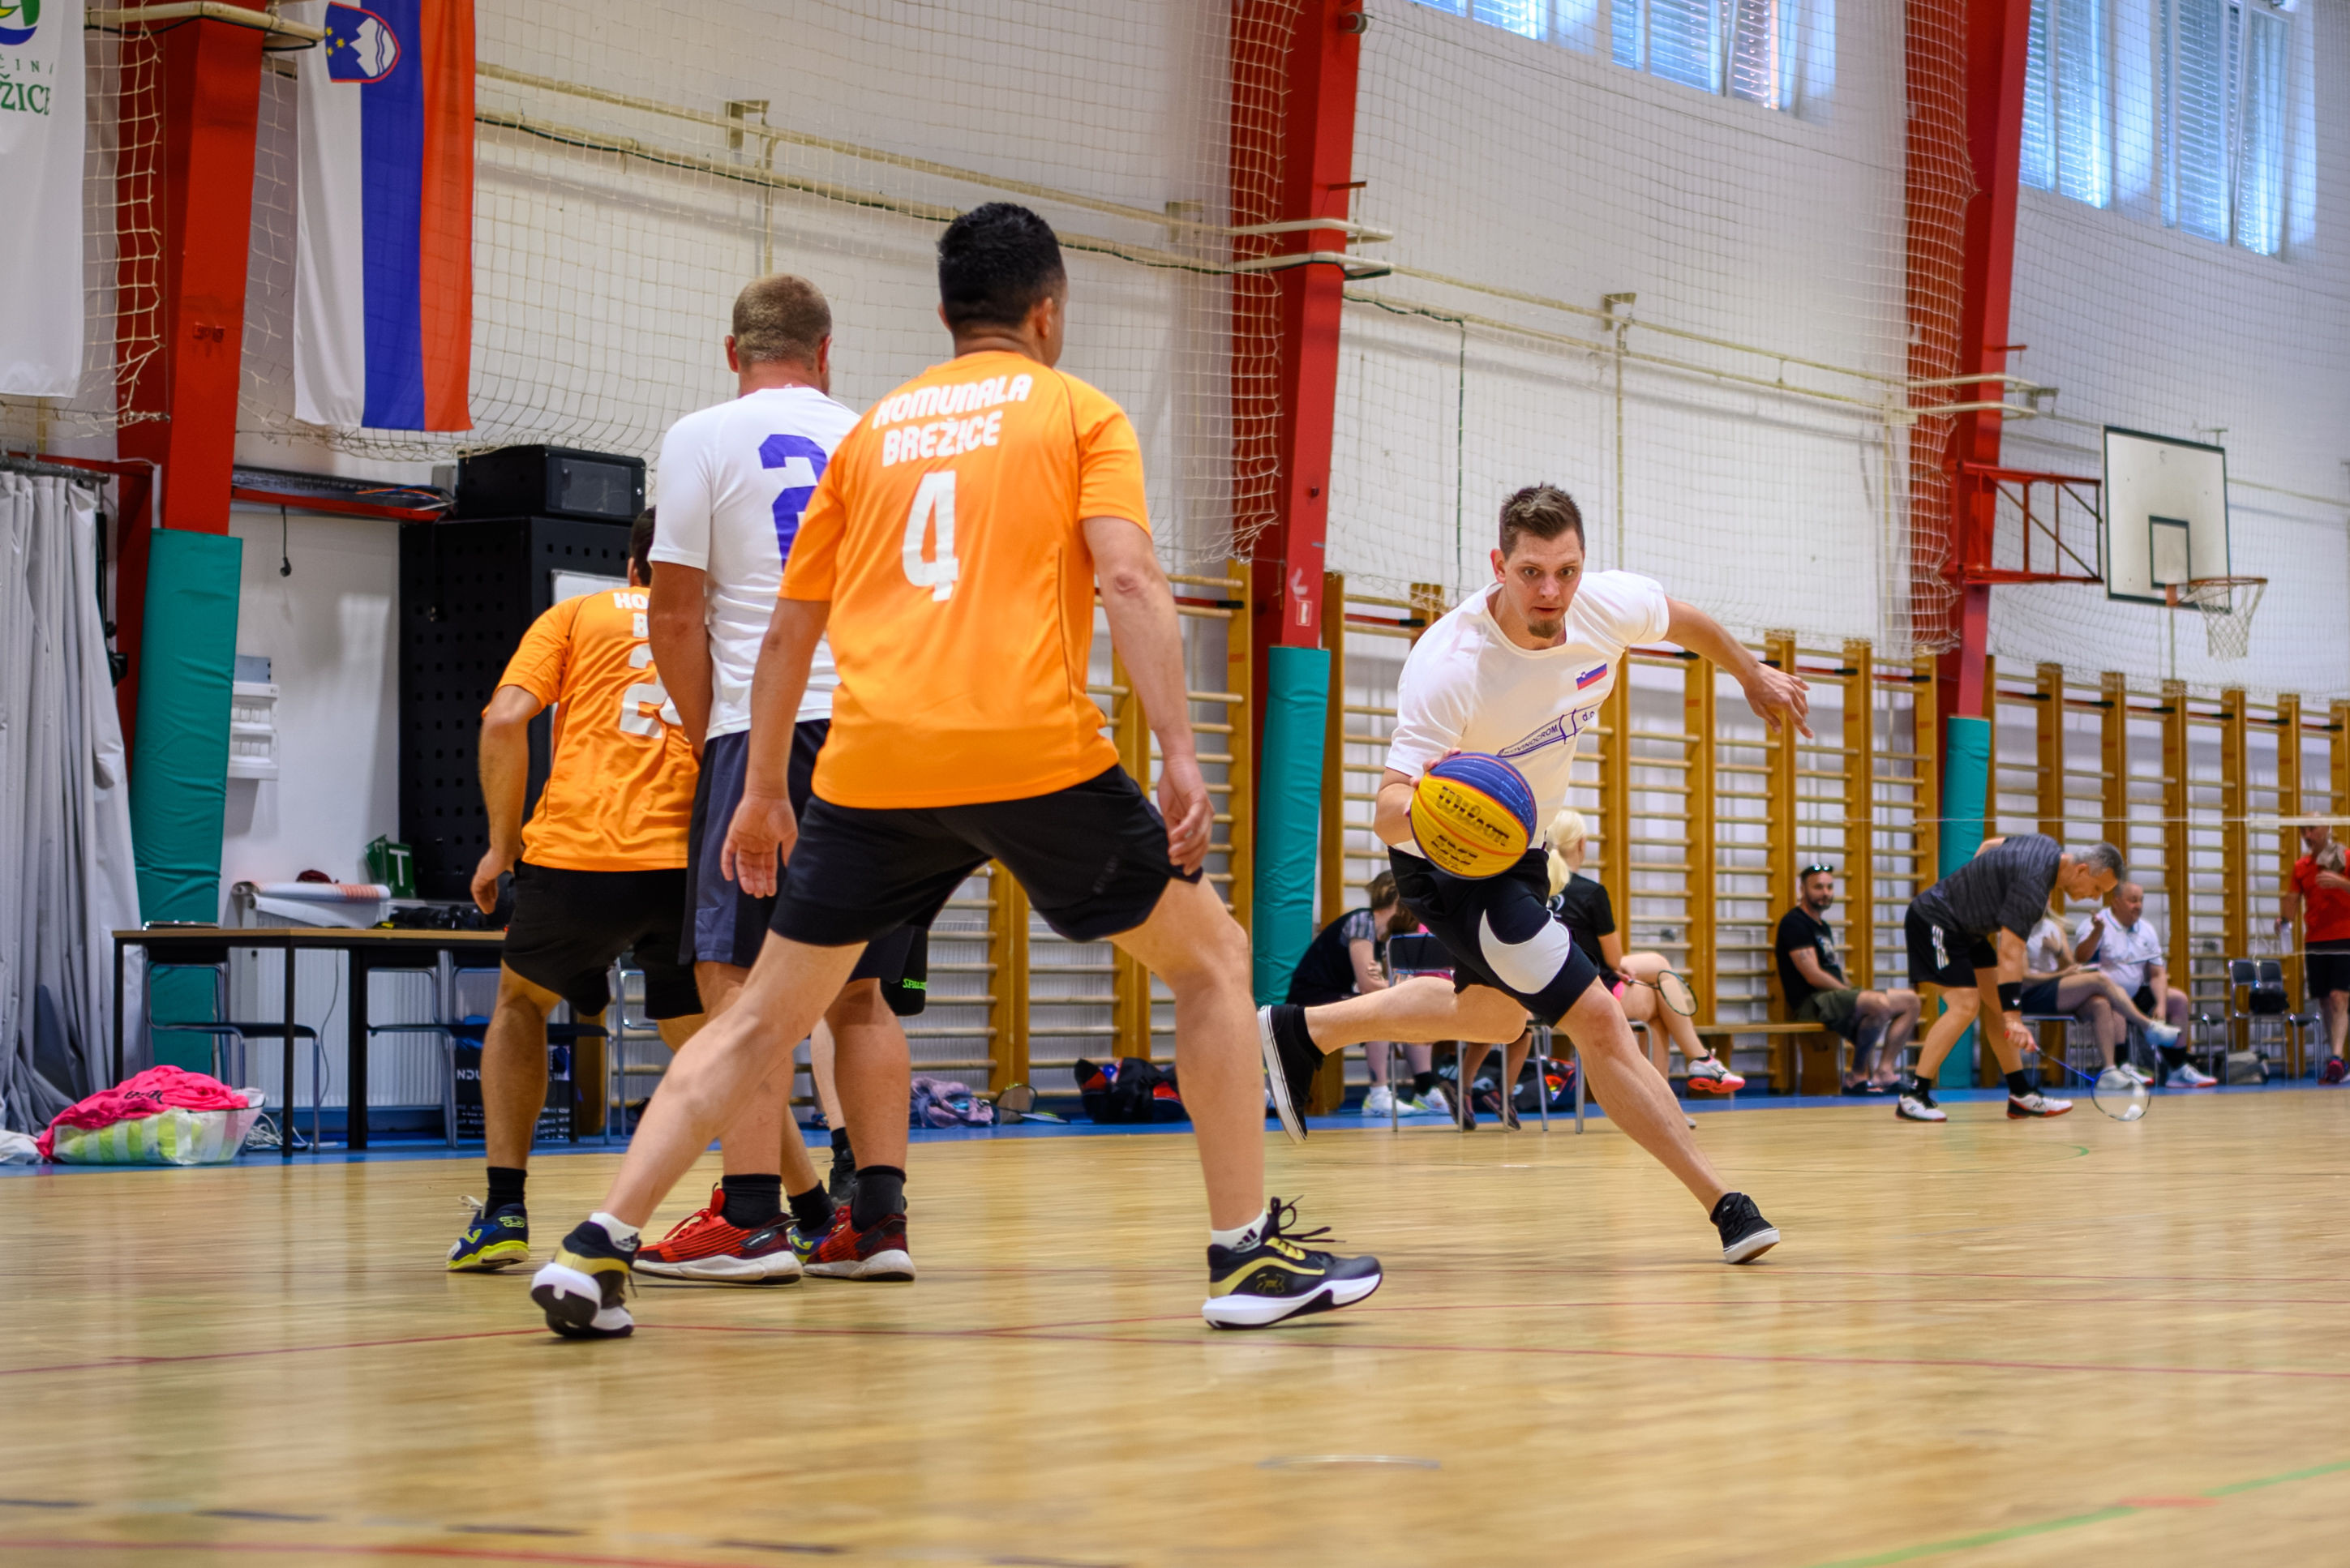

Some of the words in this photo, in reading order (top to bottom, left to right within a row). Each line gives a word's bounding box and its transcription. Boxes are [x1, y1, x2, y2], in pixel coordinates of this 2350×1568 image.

[882, 410, 1003, 467] BREŽICE
[758, 434, 829, 574] 2
[902, 470, 959, 602] 4
[388, 848, 410, 887] T
